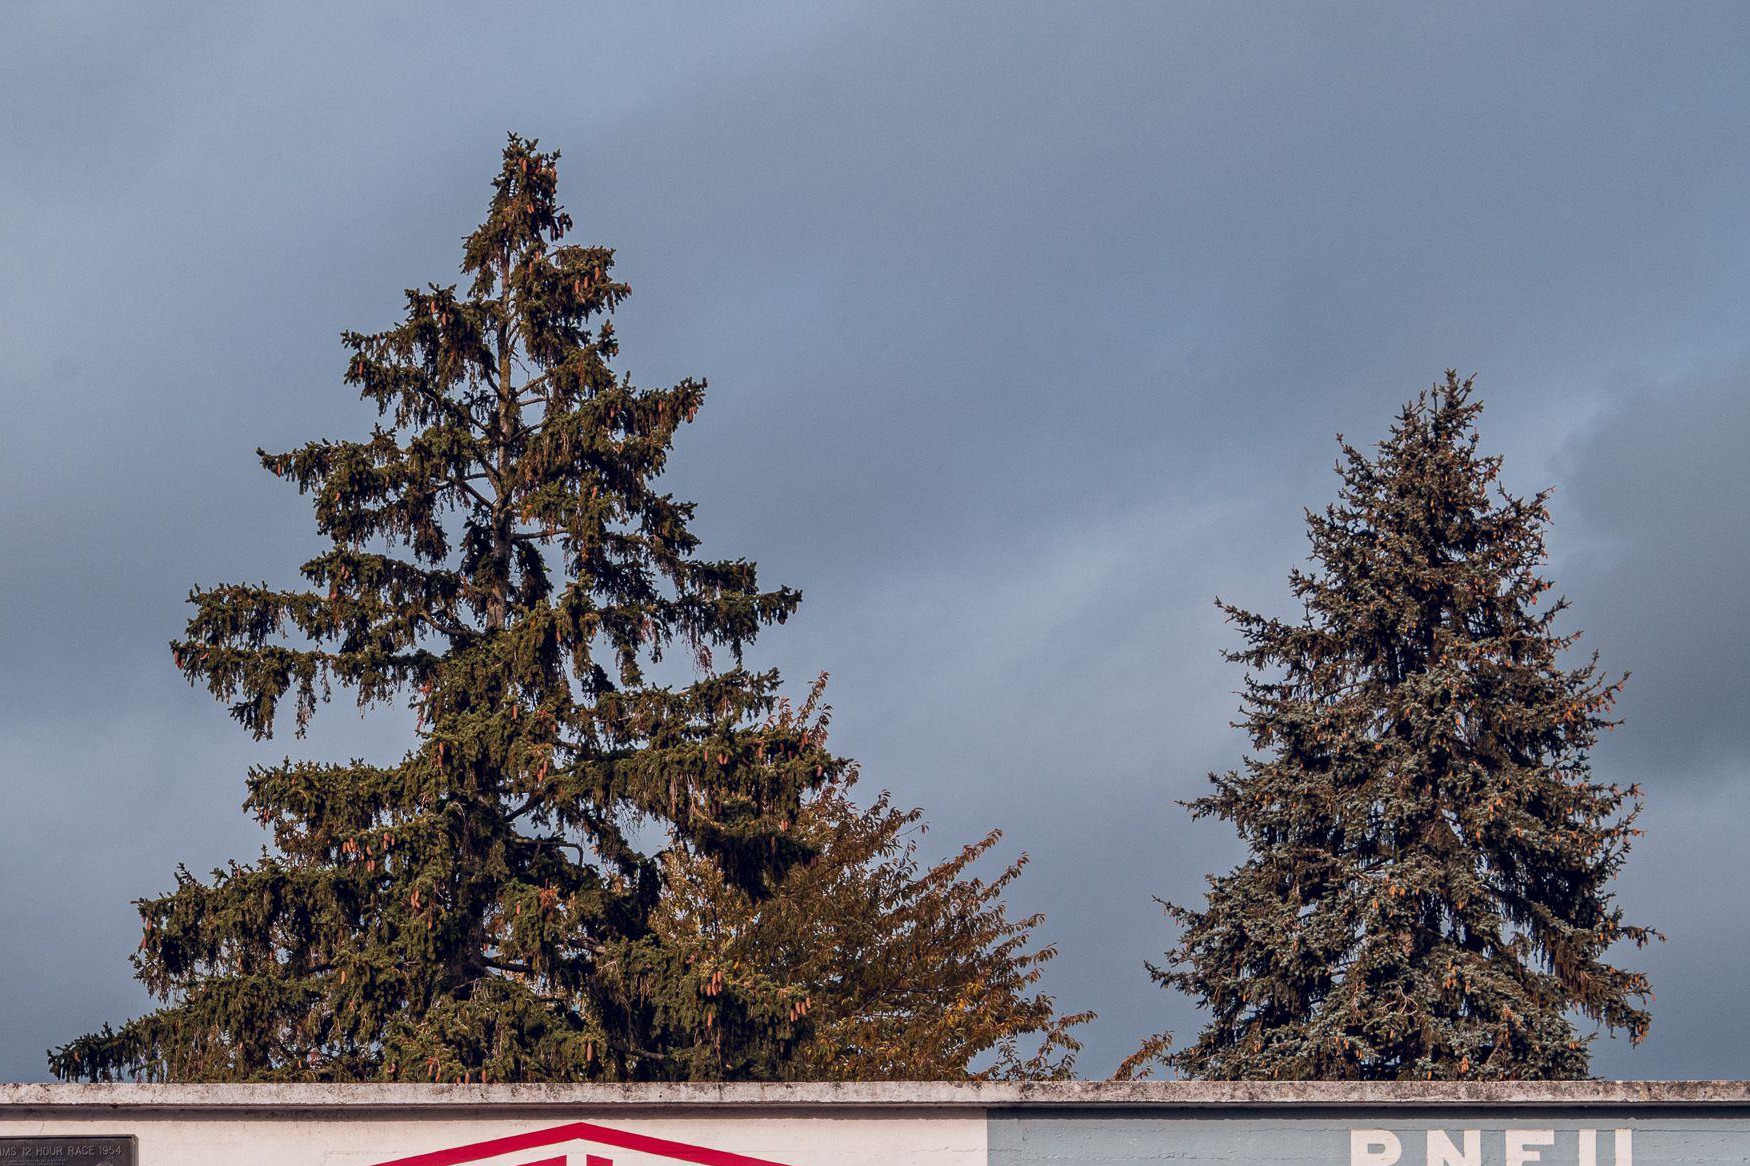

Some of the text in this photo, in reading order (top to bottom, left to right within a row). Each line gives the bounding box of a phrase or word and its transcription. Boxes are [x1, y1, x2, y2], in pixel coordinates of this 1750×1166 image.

[21, 1145, 33, 1156] 12
[36, 1145, 64, 1156] HOUR
[67, 1145, 96, 1156] RACE
[99, 1145, 122, 1156] 1954
